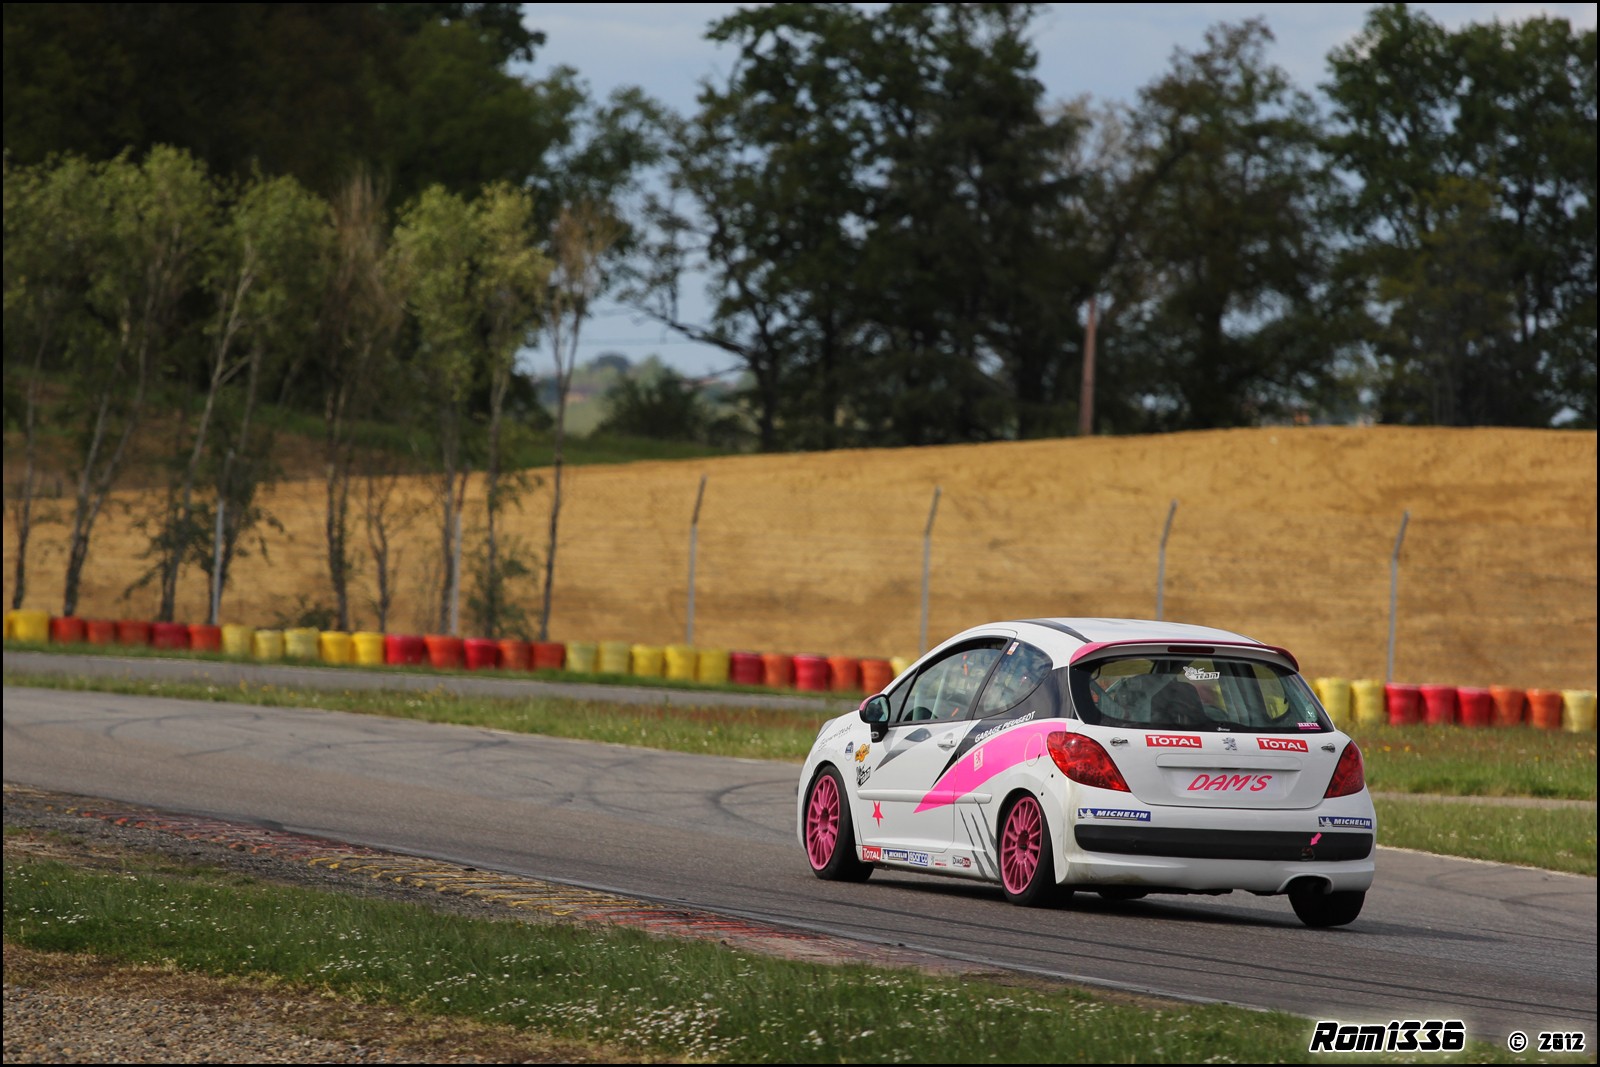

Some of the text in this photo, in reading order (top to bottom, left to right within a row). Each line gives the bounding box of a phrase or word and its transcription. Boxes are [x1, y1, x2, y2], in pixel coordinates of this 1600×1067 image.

[975, 711, 1036, 743] GARAGE PEUGEOT
[1148, 735, 1200, 747] TOTAL
[1259, 738, 1306, 751] TOTAL
[1187, 774, 1272, 792] DAM'S
[1096, 810, 1148, 819] MICHELIN
[1333, 818, 1371, 826] MICHELIN
[863, 847, 880, 860] TOTAL
[889, 851, 908, 859] MICHELIN
